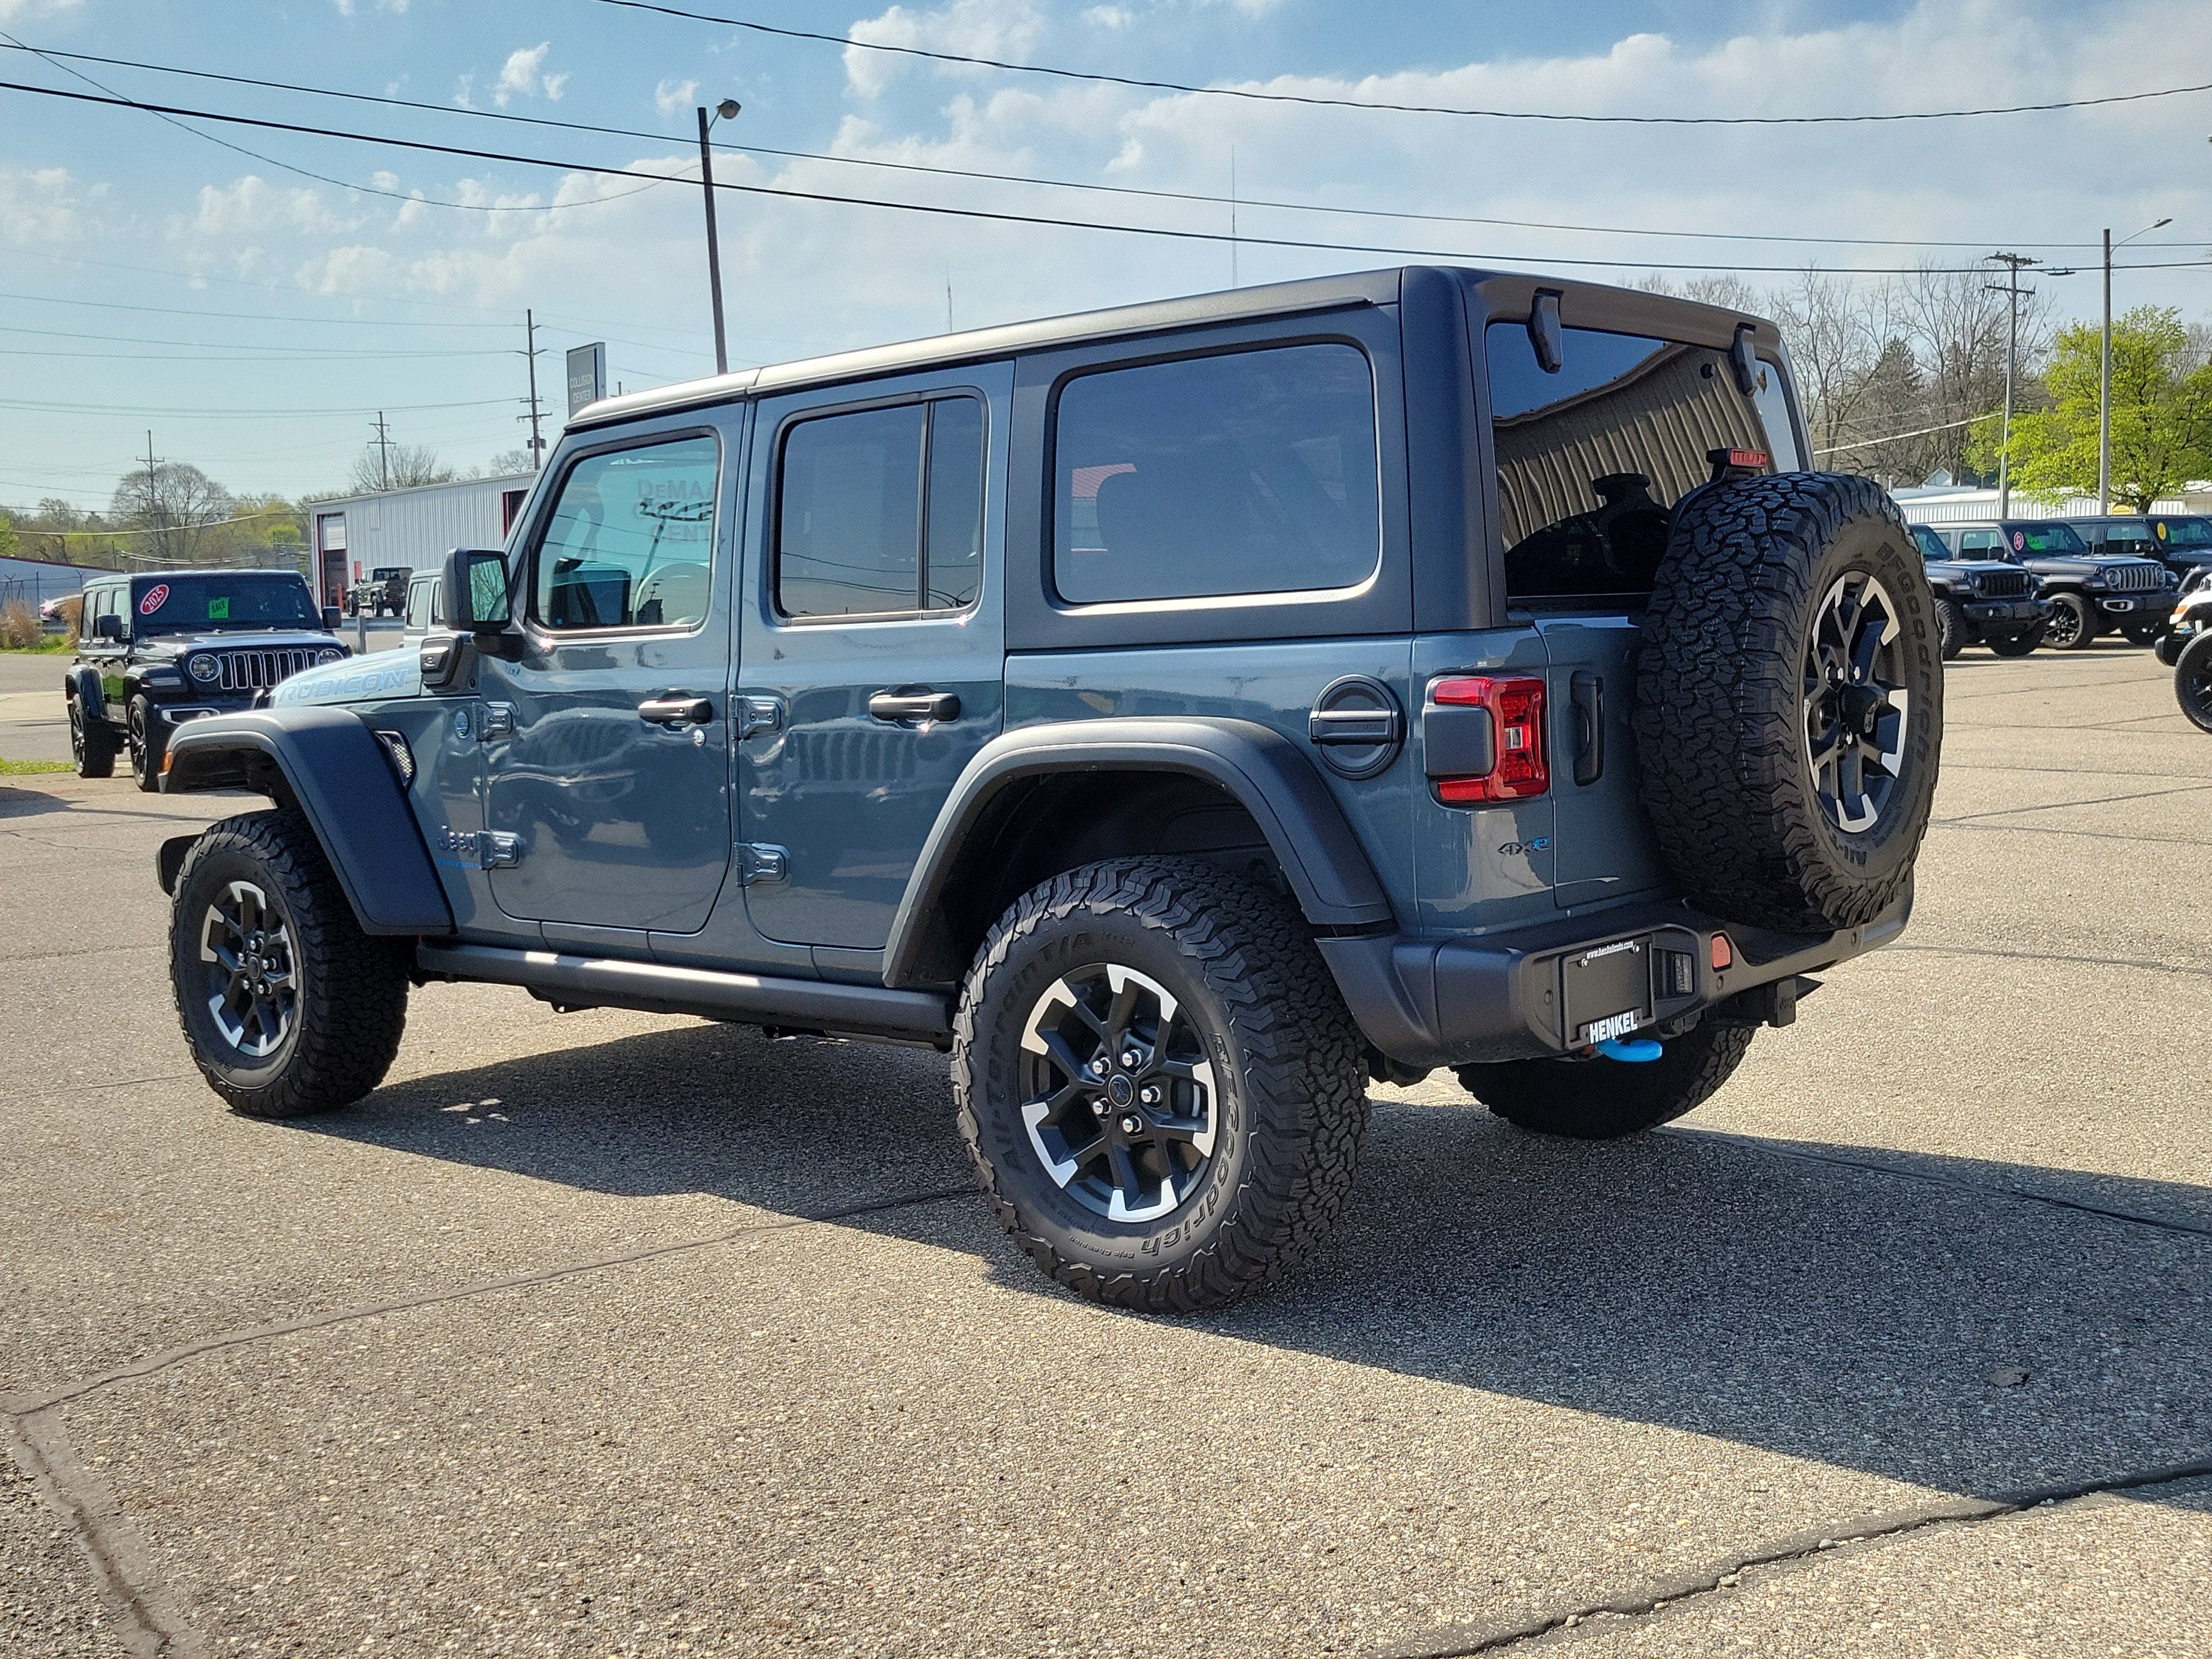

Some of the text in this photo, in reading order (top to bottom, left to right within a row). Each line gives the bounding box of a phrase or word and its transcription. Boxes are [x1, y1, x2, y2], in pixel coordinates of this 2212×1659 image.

[569, 374, 594, 389] COLLISION
[573, 389, 591, 404] CENTER
[145, 588, 165, 611] 2025
[278, 669, 409, 703] RUBICON
[438, 825, 478, 857] Jeep
[1589, 1011, 1638, 1044] HENKEL
